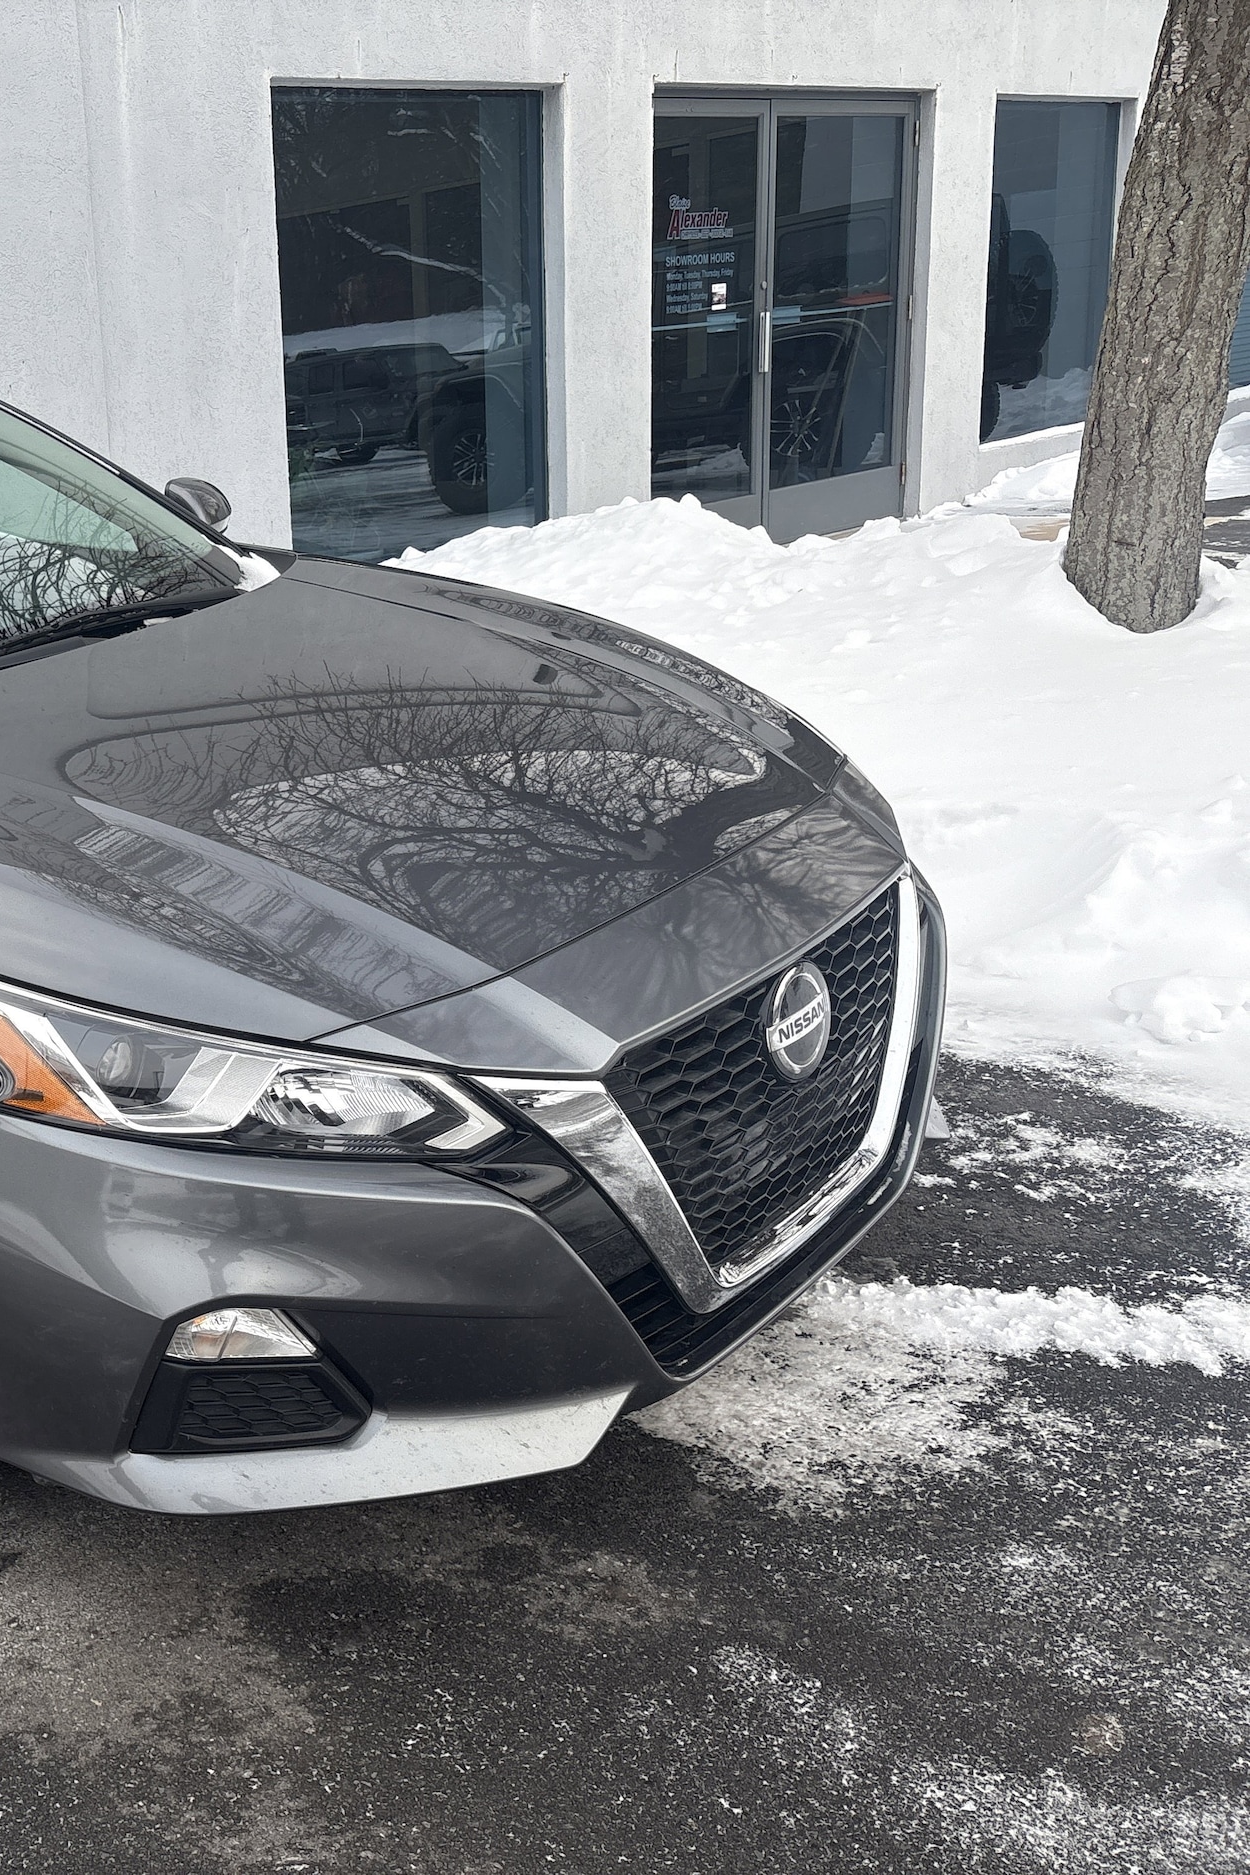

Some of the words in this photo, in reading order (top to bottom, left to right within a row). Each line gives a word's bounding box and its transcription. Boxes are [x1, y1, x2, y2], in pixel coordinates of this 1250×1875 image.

[667, 207, 729, 240] Alexander
[665, 253, 709, 267] SHOWROOM
[710, 252, 735, 264] HOURS
[777, 1001, 826, 1044] NISSAN
